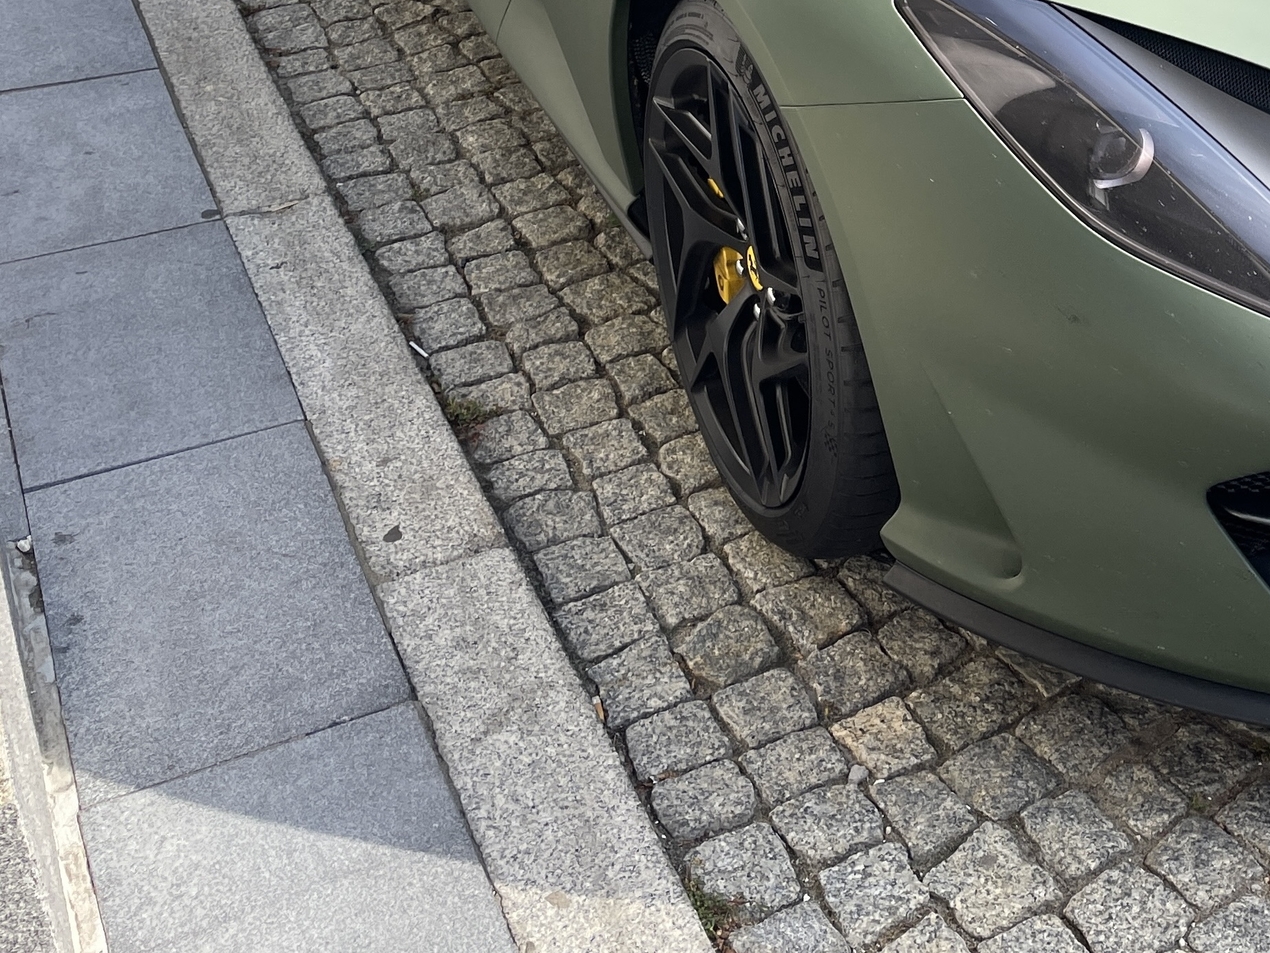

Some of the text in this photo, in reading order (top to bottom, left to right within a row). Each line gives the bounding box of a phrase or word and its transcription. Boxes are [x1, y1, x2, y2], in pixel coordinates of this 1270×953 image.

[752, 82, 821, 264] MICHELIN
[817, 286, 831, 340] PILOT
[824, 347, 836, 409] SPORT
